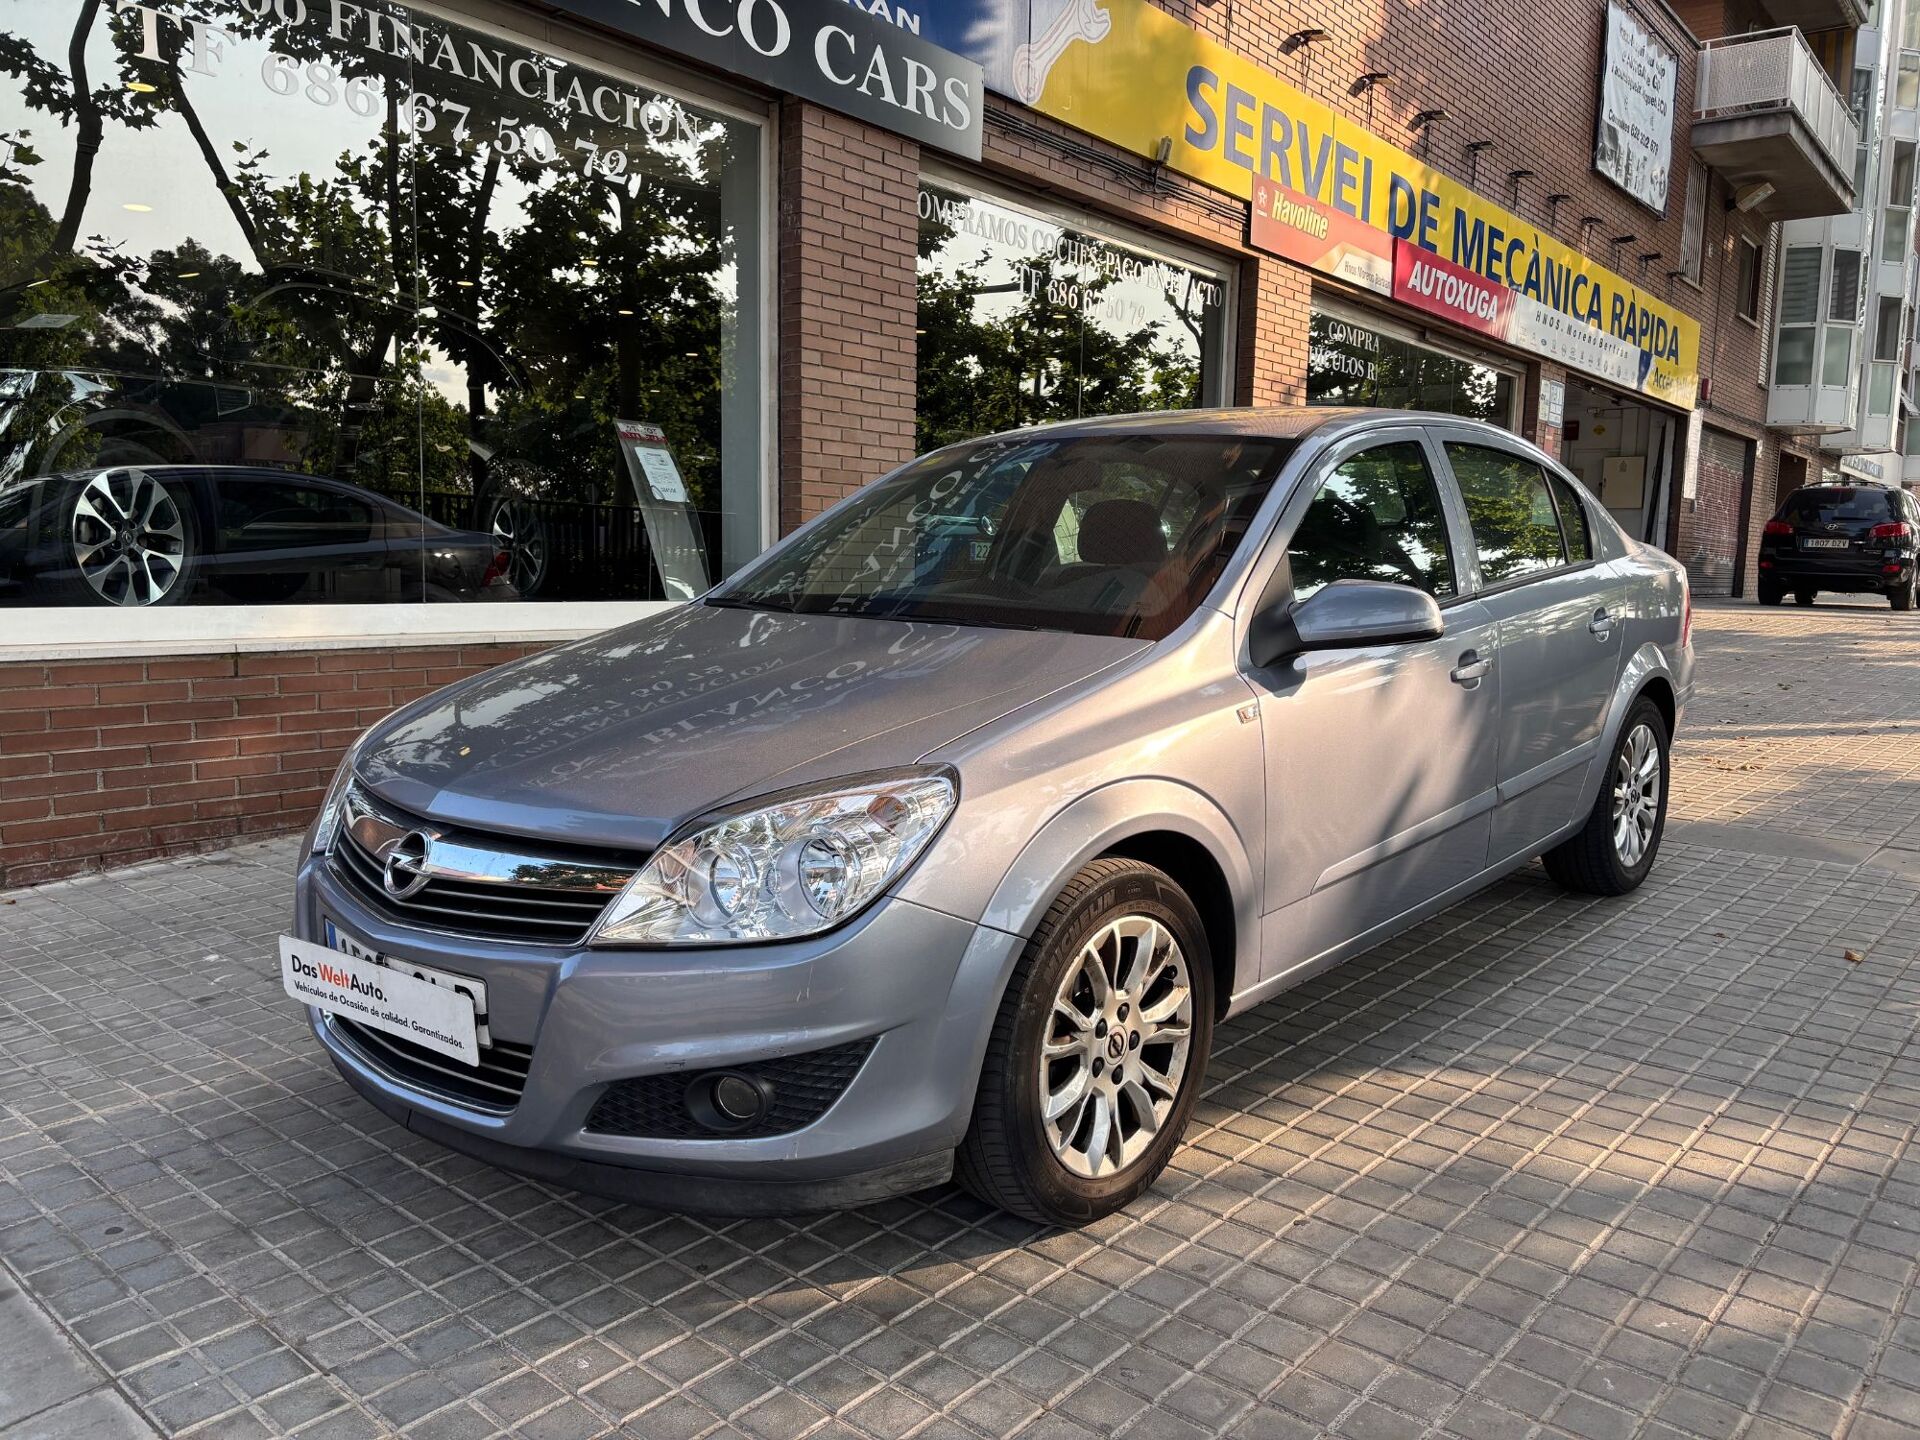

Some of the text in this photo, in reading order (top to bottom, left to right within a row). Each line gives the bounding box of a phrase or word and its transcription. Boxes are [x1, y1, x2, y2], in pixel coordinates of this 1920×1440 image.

[116, 2, 236, 77] TF
[261, 53, 380, 117] 686
[403, 93, 471, 142] 67
[494, 117, 557, 164] 50
[574, 137, 629, 185] 72
[814, 25, 971, 131] CARS
[1185, 65, 1679, 366] SERVEI DE MECÀNICA RÀPIDA
[1272, 190, 1329, 241] Havoline
[1016, 264, 1043, 300] TF
[1047, 280, 1078, 309] 686
[1188, 278, 1222, 308] ACTO
[1408, 260, 1498, 323] AUTOXUGA
[1566, 323, 1597, 346] Moreno
[329, 991, 339, 1003] de
[339, 994, 369, 1014] Ocasión
[370, 1005, 380, 1018] de
[411, 1020, 465, 1050] Garantizados.
